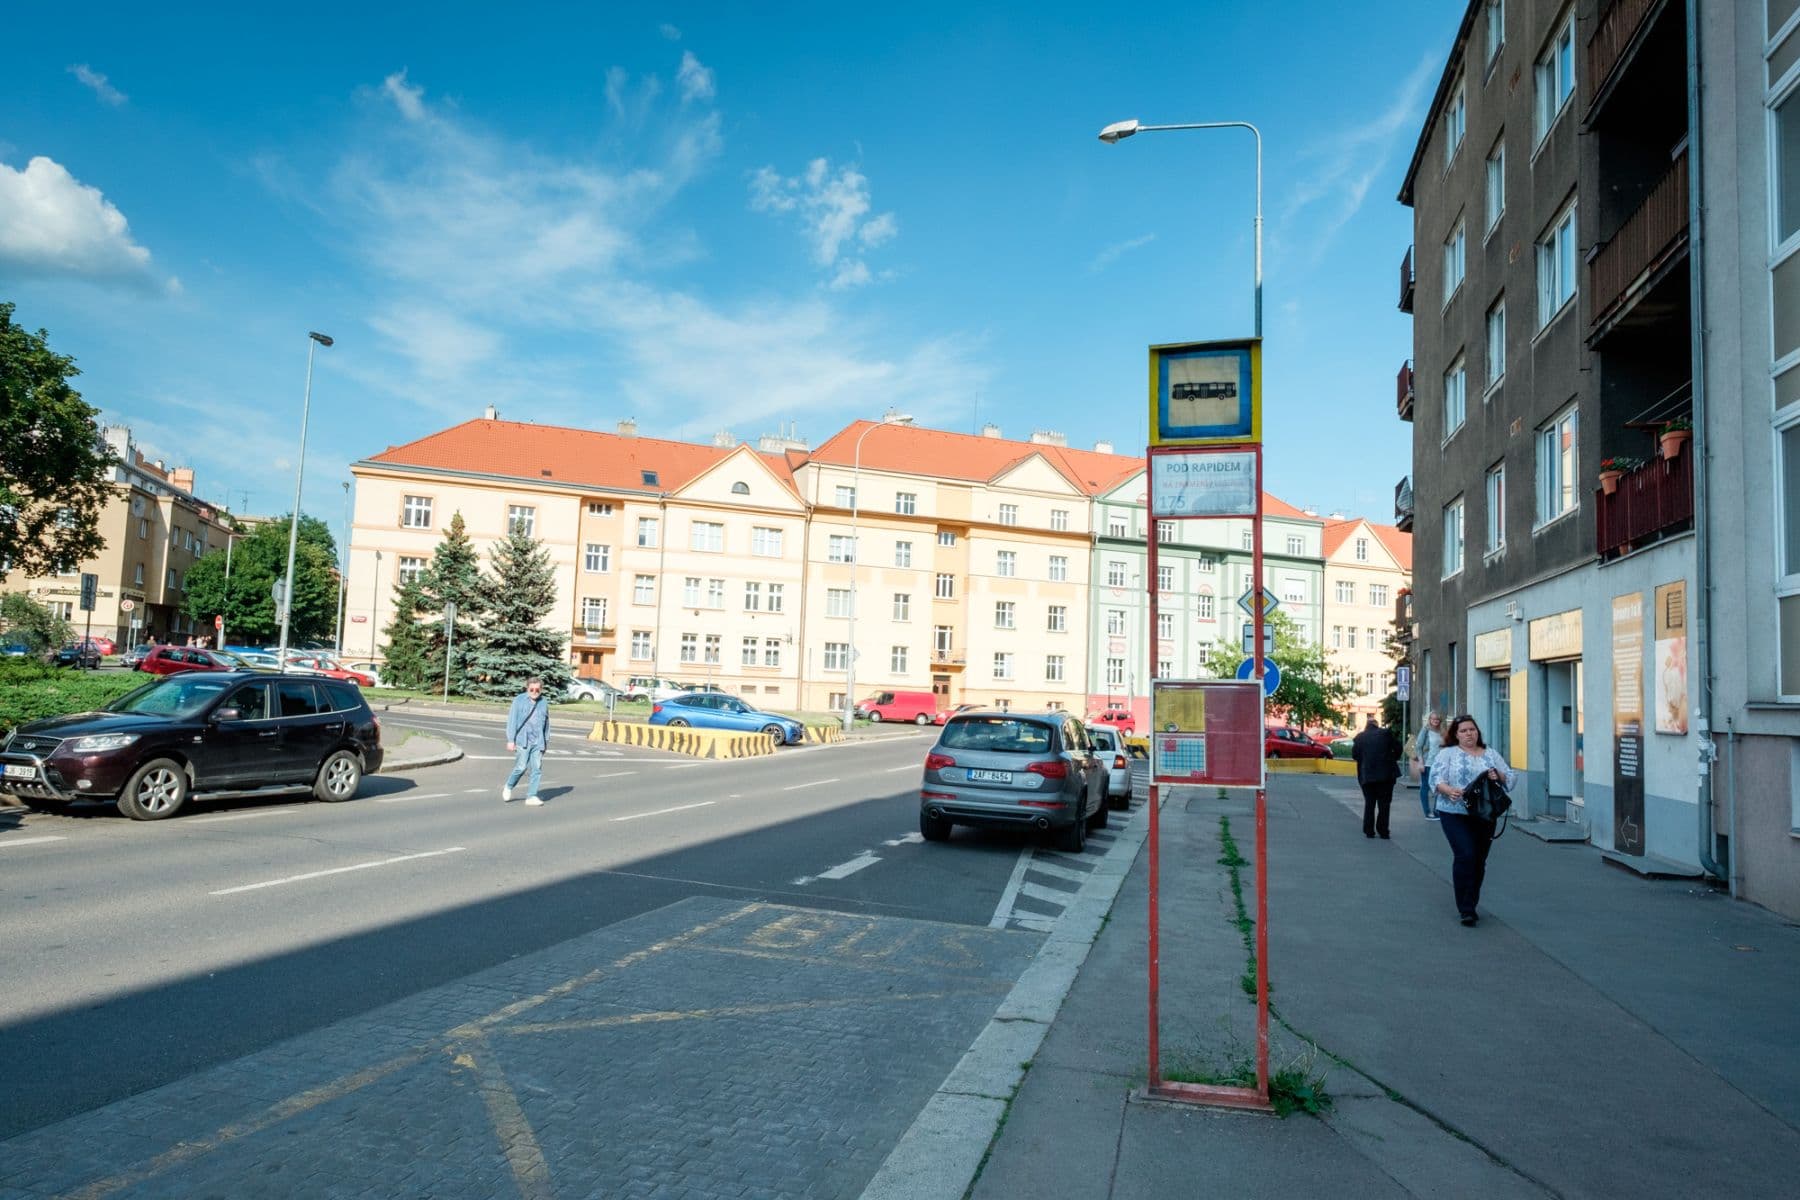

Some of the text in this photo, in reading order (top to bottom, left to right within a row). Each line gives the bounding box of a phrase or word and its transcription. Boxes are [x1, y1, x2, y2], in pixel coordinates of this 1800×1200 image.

[1166, 462, 1241, 473] POD RAPIDEM
[1159, 495, 1185, 509] 175
